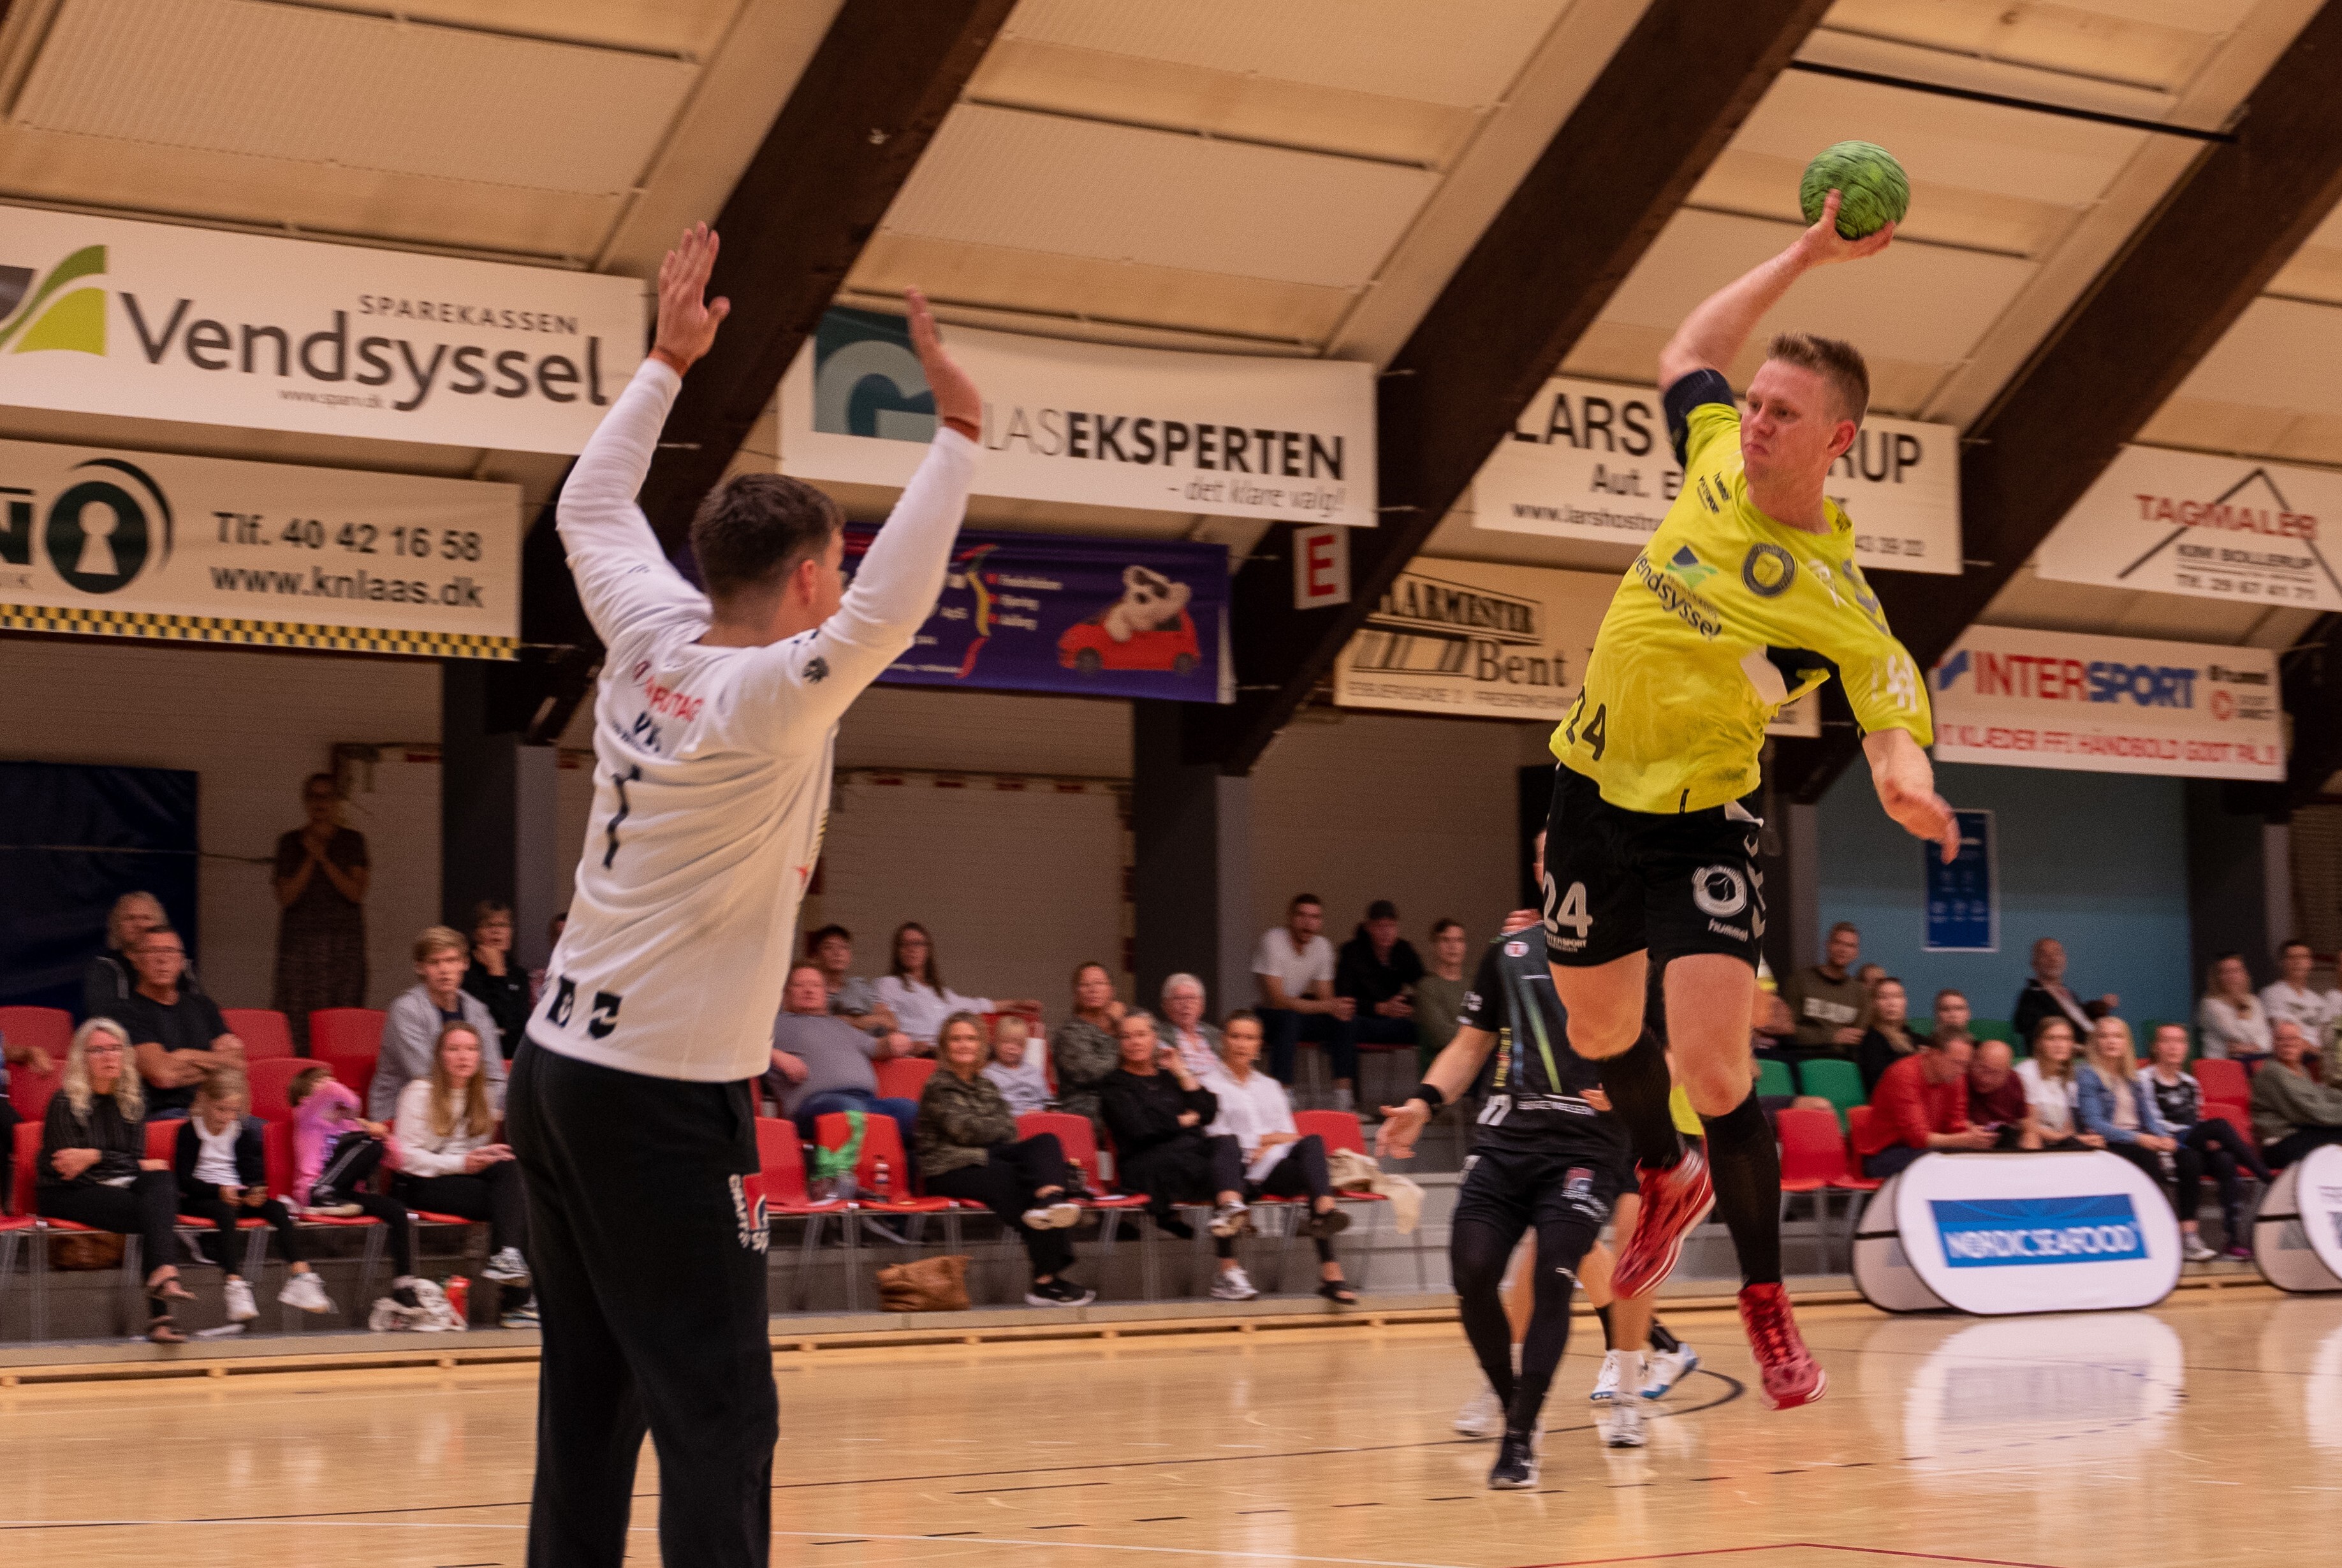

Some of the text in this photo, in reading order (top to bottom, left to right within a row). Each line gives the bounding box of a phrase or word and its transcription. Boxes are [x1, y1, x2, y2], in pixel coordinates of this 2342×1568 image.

[358, 293, 579, 336] SPAREKASSEN
[119, 291, 610, 411] Vendsyssel
[983, 400, 1347, 481] LASEKSPERTEN
[1184, 476, 1224, 503] det
[1229, 477, 1285, 508] klare
[1588, 463, 1651, 498] Aut.
[212, 511, 483, 563] Tlf. 40 42 16 58
[209, 566, 485, 609] www.knlaas.dk
[1307, 533, 1336, 597] E
[1473, 639, 1568, 688] Bent
[1974, 650, 2198, 709] INTERSPORT
[1945, 1222, 2138, 1259] NORDIC SEAFOOD
